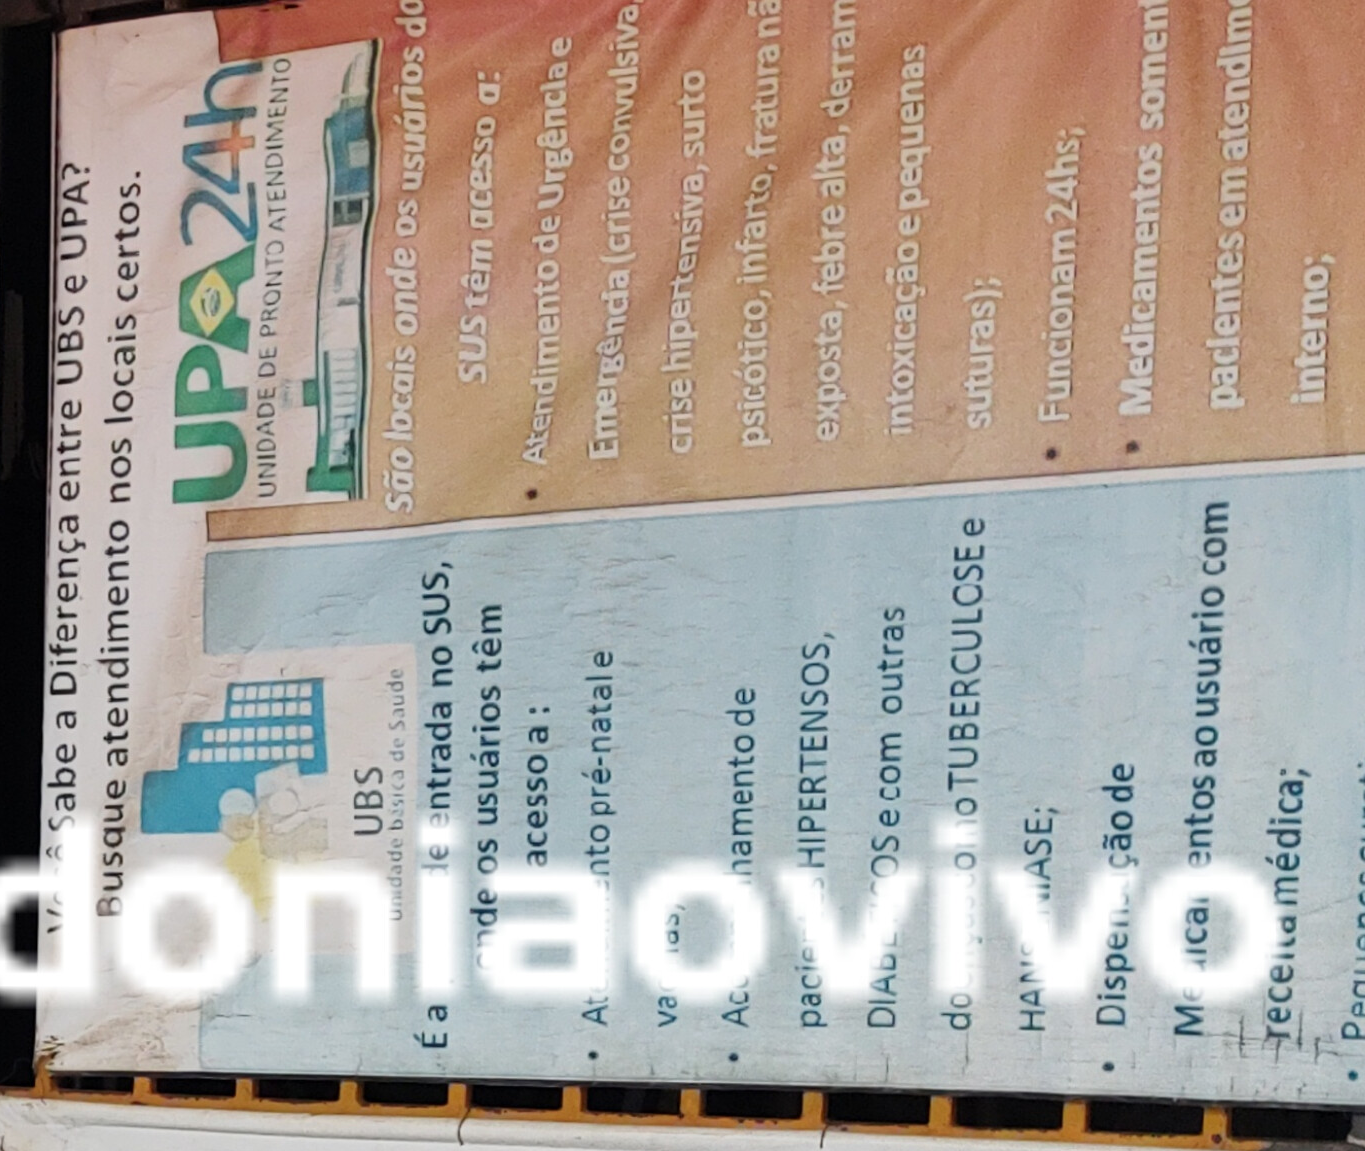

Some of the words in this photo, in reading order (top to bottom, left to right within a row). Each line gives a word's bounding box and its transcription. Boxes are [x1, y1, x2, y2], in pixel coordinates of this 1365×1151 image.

[265, 59, 291, 232] ATENDIMENTO
[394, 47, 426, 189] usuários
[537, 62, 573, 209] Urgência
[678, 71, 704, 157] surto
[746, 44, 779, 158] fratura
[811, 125, 850, 196] alta,
[900, 44, 930, 209] pequenas
[61, 163, 90, 260] UPA?
[470, 117, 495, 228] acesso
[600, 177, 635, 262] (crise
[735, 164, 777, 283] infarto,
[1045, 128, 1085, 223] 24hs;
[115, 171, 141, 302] certos.
[260, 241, 284, 337] PRONTO
[386, 248, 417, 334] onde
[461, 240, 492, 308] têm
[661, 164, 709, 371] hipertensiva,
[812, 205, 845, 294] febre
[1119, 143, 1162, 414] Medicamentos
[57, 307, 84, 384] UBS
[104, 314, 137, 424] locais
[459, 316, 486, 383] SUS
[523, 261, 559, 464] Atendimento
[589, 270, 629, 459] Emergência
[733, 290, 771, 446] psicótico,
[815, 301, 848, 441] exposta,
[884, 242, 925, 434] intoxicação
[964, 278, 1002, 428] suturas);
[1039, 229, 1075, 420] Funcionam
[1206, 232, 1244, 408] pacientes
[1291, 254, 1335, 403] interno;
[58, 400, 82, 501] entre
[257, 387, 276, 497] UNIDADE
[382, 346, 415, 440] locais
[663, 379, 692, 453] crise
[384, 448, 413, 512] São
[50, 515, 86, 695] Diferença
[96, 520, 129, 766] atendimento
[422, 562, 453, 635] SUS,
[472, 604, 502, 673] têm
[1188, 586, 1225, 717] usuário
[877, 607, 905, 714] outras
[948, 545, 985, 792] TUBERCULOSE
[48, 744, 77, 831] Sabe
[354, 767, 383, 836] UBS
[424, 702, 452, 821] entrada
[470, 685, 501, 825] usuários
[581, 676, 616, 816] pré-natal
[797, 632, 835, 868] HIPERTENSOS,
[96, 780, 126, 917] Busque
[526, 755, 548, 867] acesso
[1265, 769, 1311, 906] médica;
